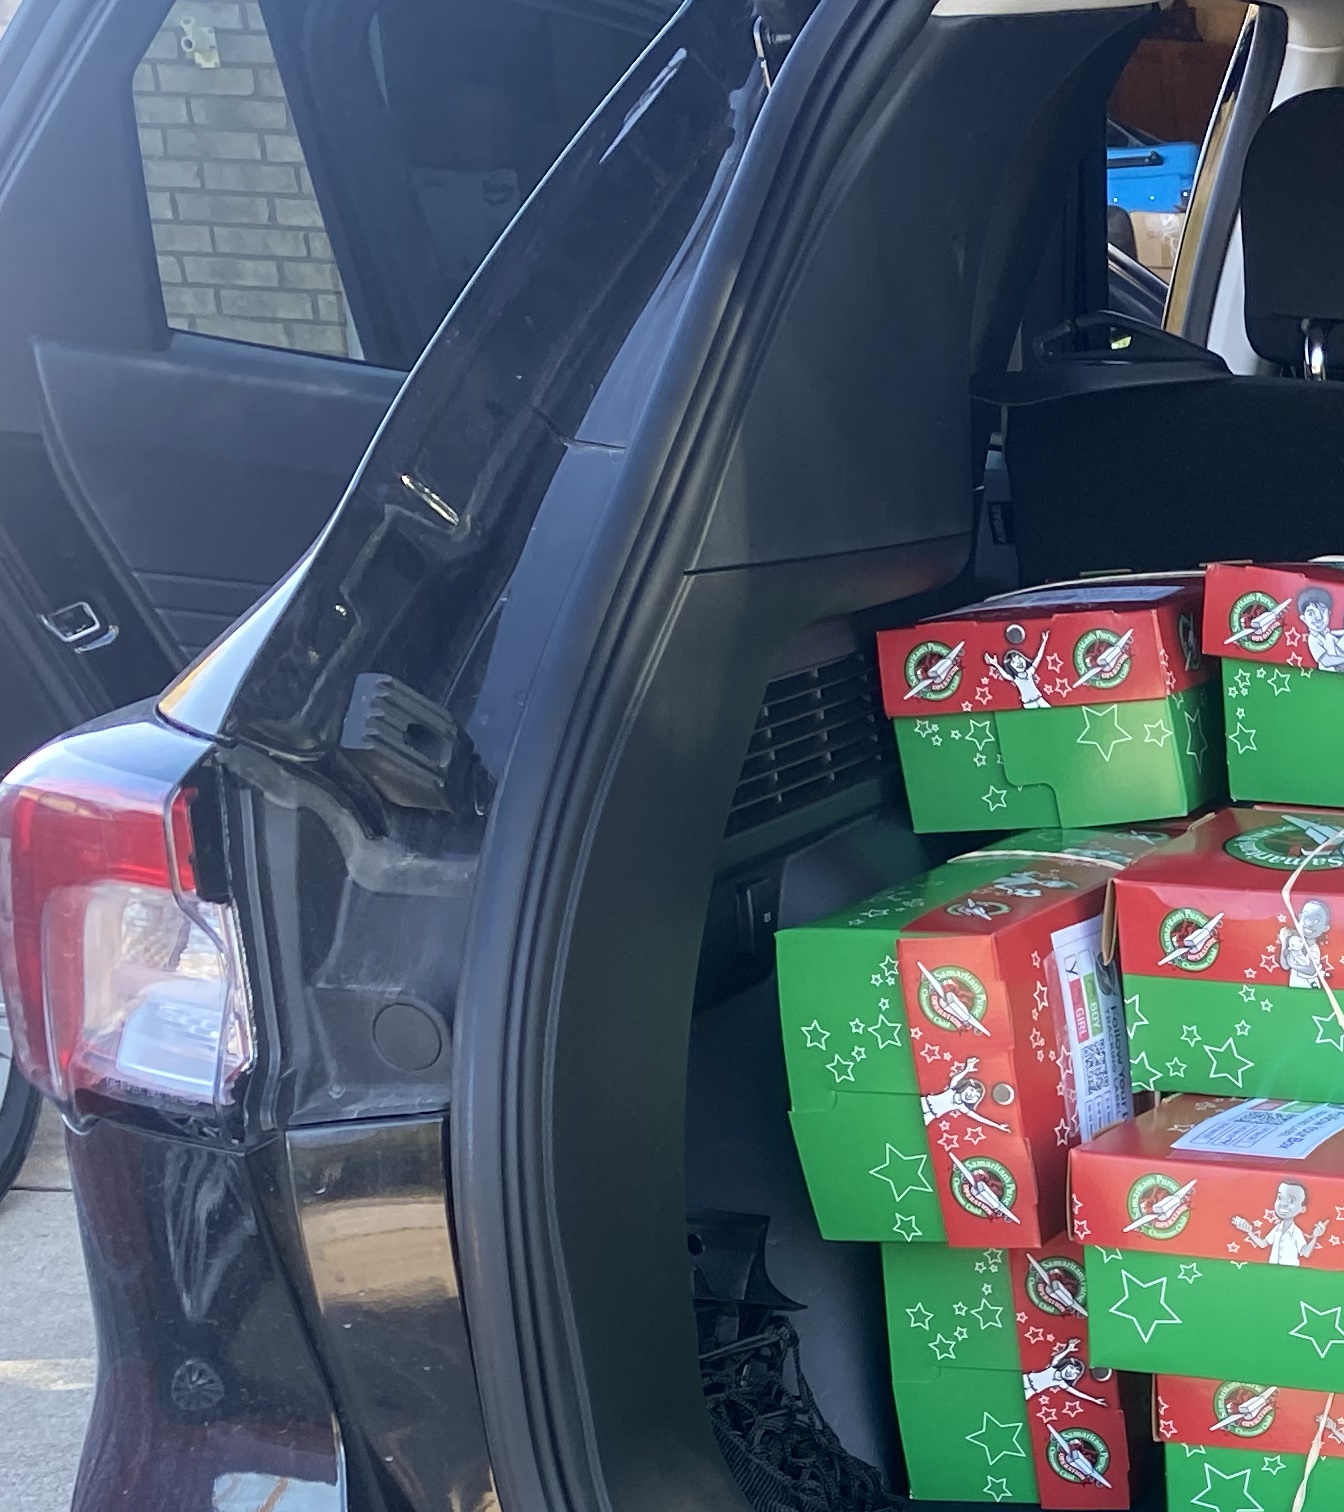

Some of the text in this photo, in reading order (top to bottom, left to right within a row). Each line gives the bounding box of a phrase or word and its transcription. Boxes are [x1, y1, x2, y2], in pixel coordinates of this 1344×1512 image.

[1185, 909, 1207, 926] Purse
[974, 995, 986, 1019] Purse
[1089, 1001, 1101, 1028] BOY
[1075, 1007, 1087, 1039] GIRL
[1157, 1176, 1180, 1190] Purse
[1003, 1184, 1016, 1205] Purse
[1097, 1451, 1108, 1472] Purse
